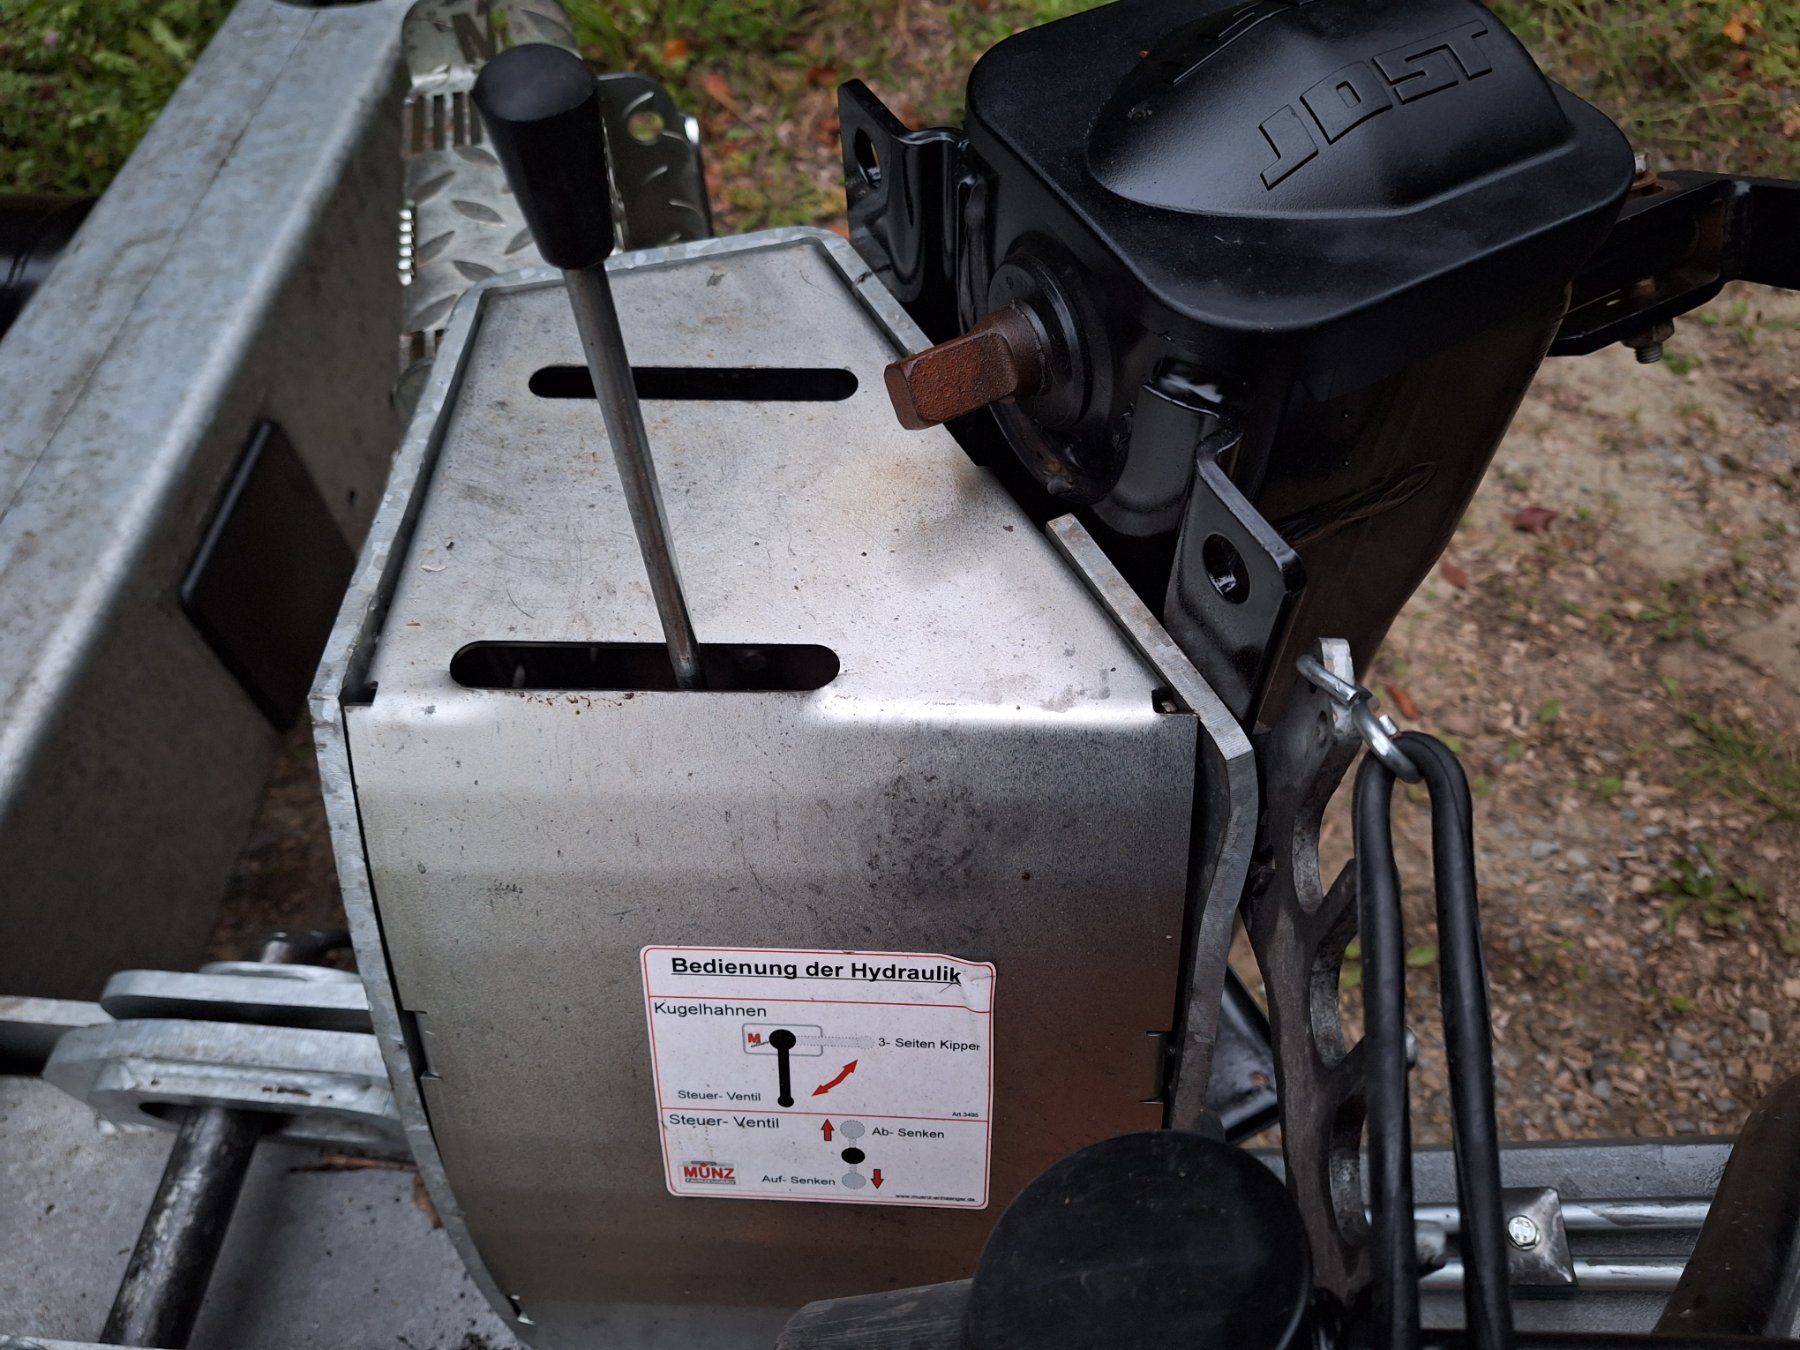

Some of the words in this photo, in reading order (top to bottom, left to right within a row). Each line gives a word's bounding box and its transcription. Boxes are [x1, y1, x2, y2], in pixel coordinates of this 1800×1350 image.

[1259, 19, 1492, 191] JOST
[672, 958, 797, 978] Bedienung
[806, 964, 843, 977] der
[851, 964, 961, 983] Hydraulik
[655, 1002, 767, 1017] Kugelhahnen
[879, 1038, 890, 1048] 3-
[896, 1038, 935, 1049] Seiten
[940, 1039, 980, 1054] Kipper
[678, 1091, 723, 1101] Steuer-
[727, 1091, 761, 1101] Ventil
[669, 1114, 728, 1127] Steuer-
[733, 1116, 779, 1129] Ventil
[873, 1127, 894, 1138] Ab-
[898, 1128, 944, 1139] Senken
[762, 1175, 786, 1185] Auf-
[791, 1175, 835, 1186] Senken
